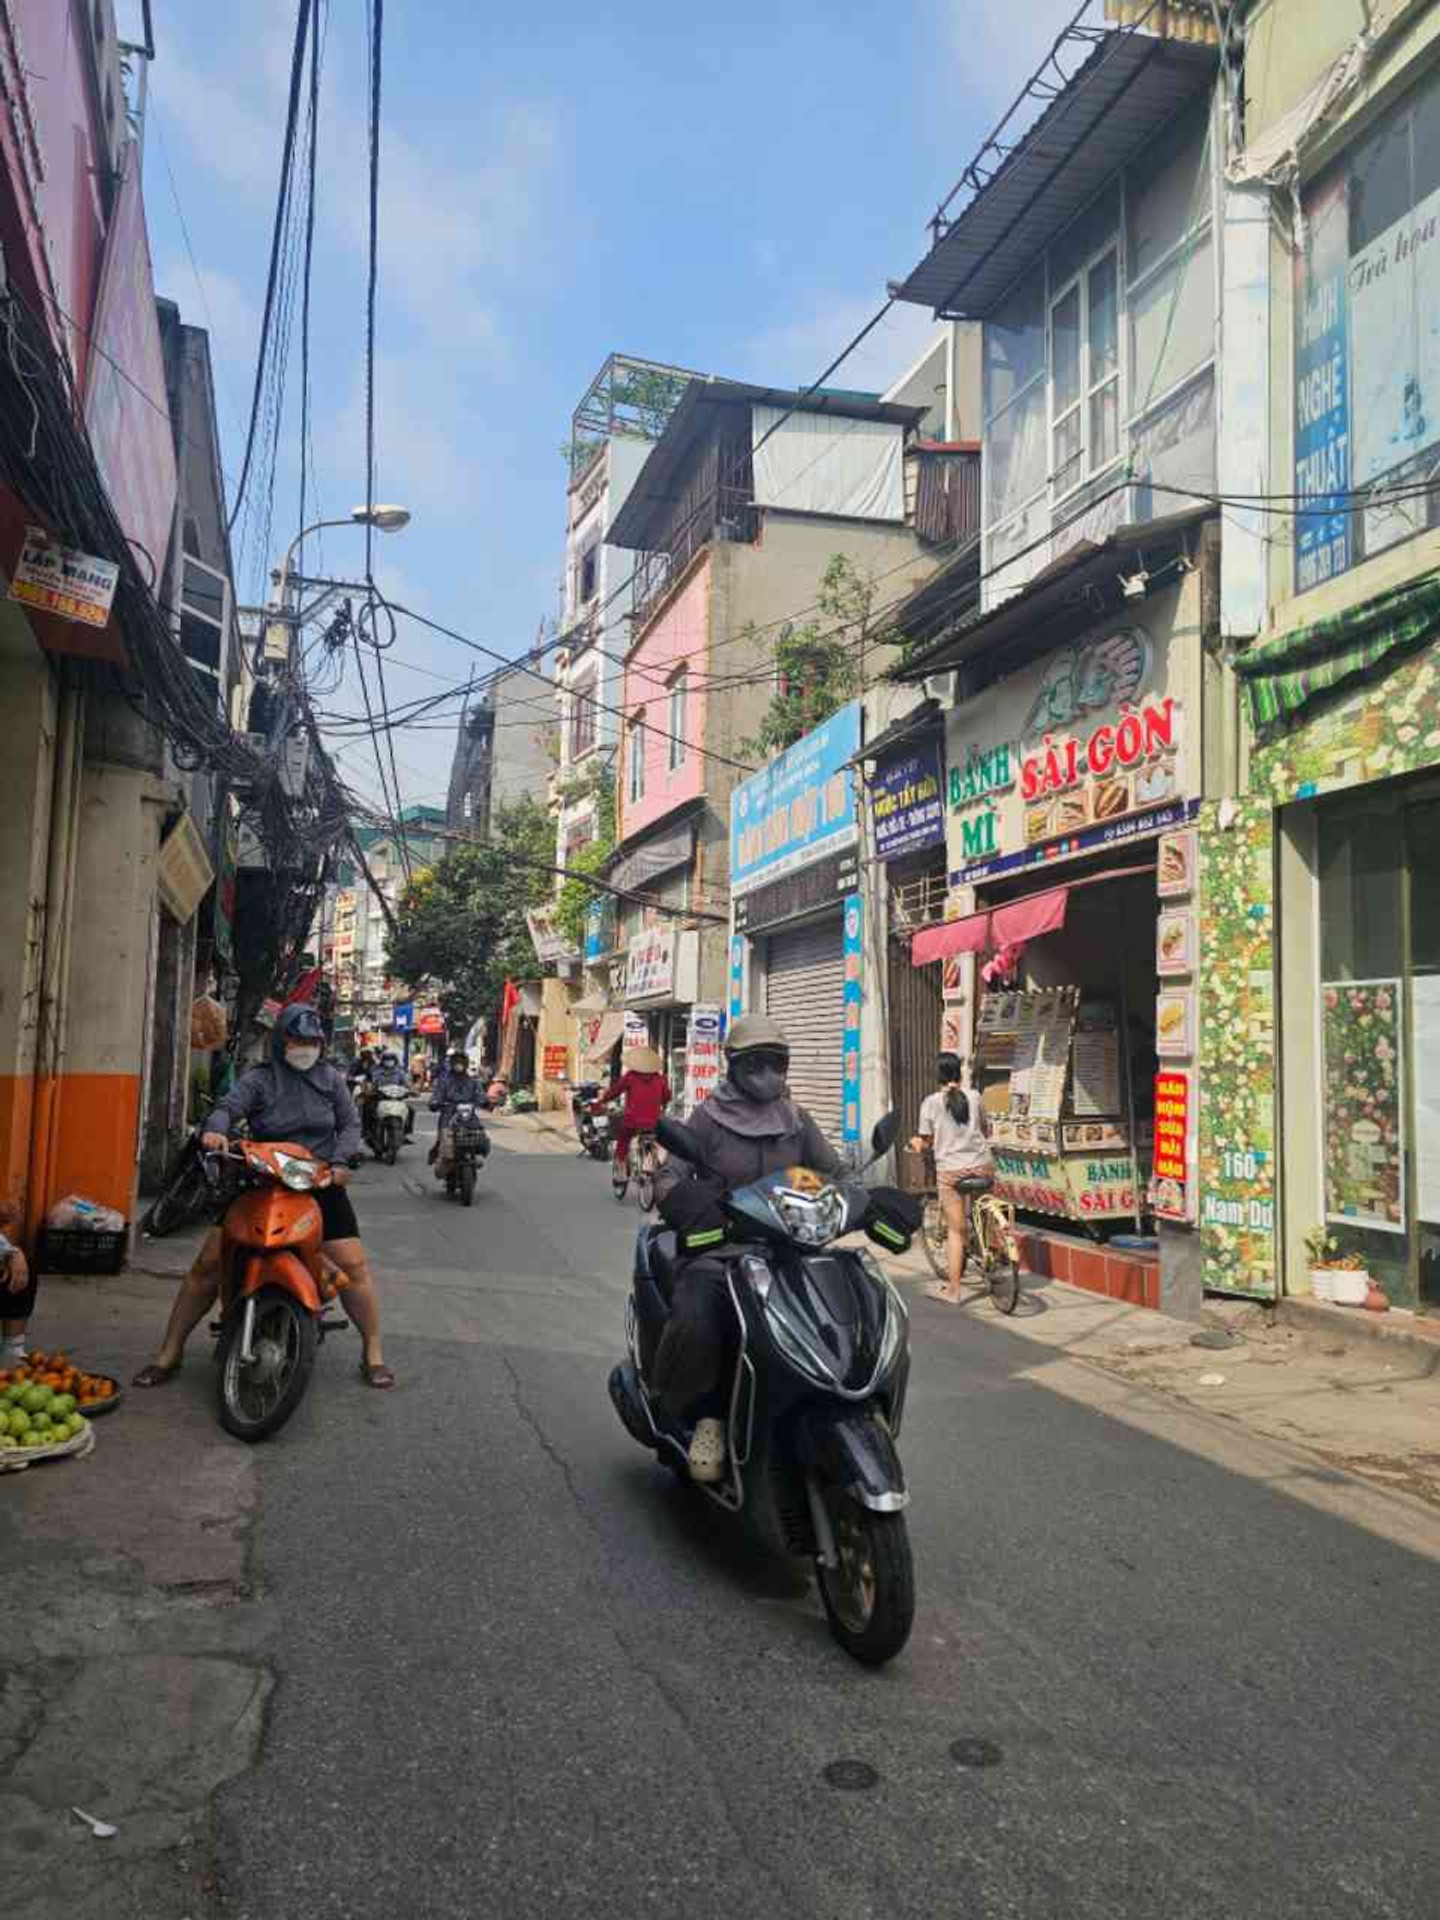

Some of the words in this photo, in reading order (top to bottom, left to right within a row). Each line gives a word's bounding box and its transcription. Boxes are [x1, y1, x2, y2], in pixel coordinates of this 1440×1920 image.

[948, 741, 1010, 805] BÁNH
[1021, 731, 1079, 800] SÀI
[1087, 696, 1174, 774] GÒN
[961, 796, 996, 858] MÌ
[1224, 1151, 1256, 1180] 160
[1205, 1196, 1244, 1225] Nam
